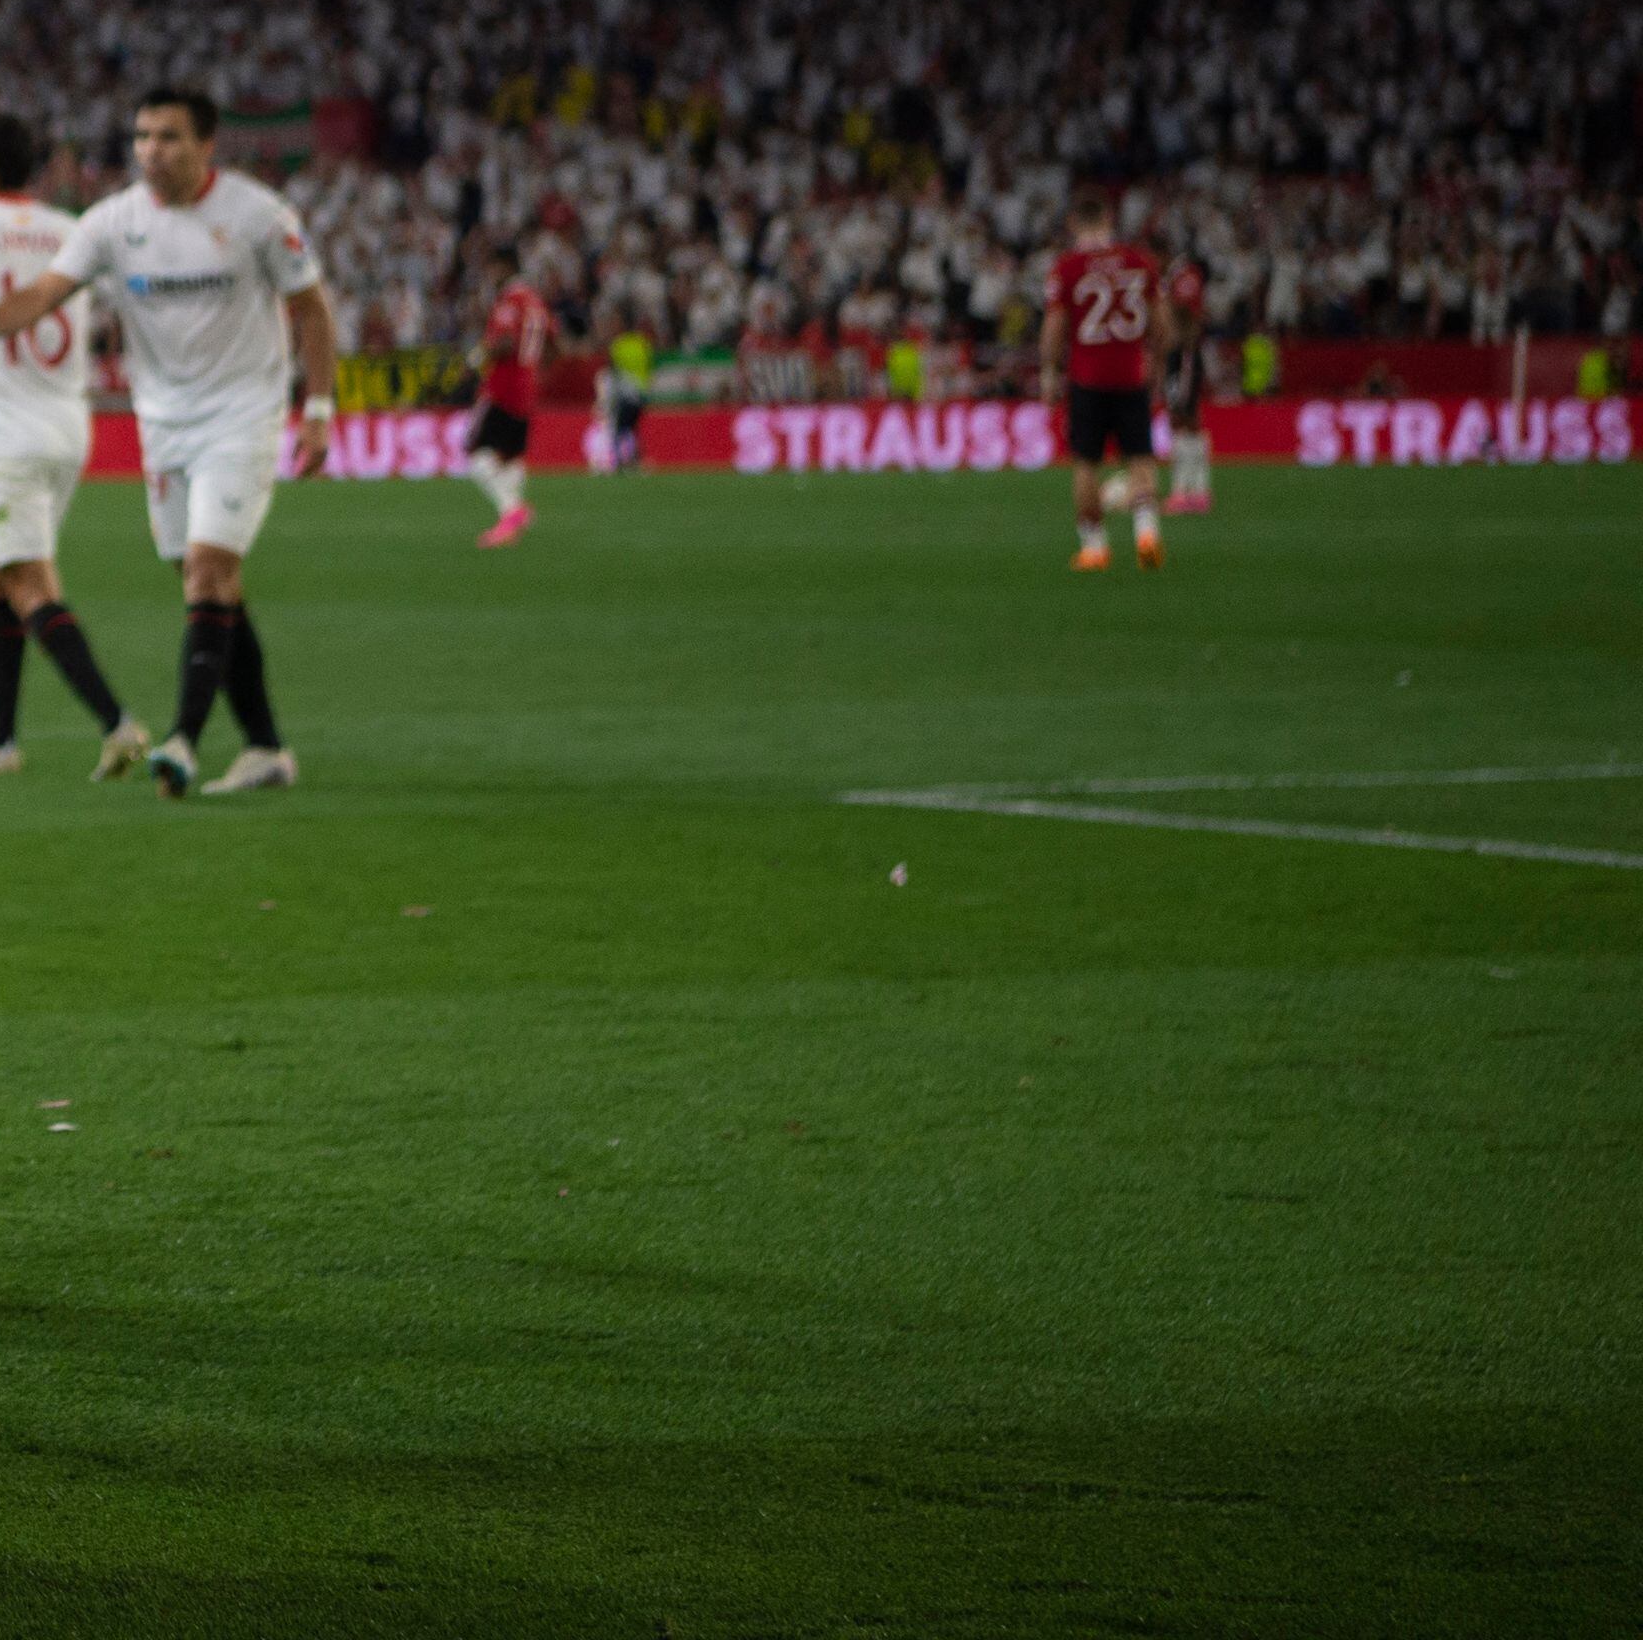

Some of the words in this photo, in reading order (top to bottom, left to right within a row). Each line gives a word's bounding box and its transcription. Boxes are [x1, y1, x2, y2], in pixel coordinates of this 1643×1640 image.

[1072, 271, 1149, 347] 23
[730, 403, 1055, 473] STRAUSS
[1294, 396, 1635, 467] STRAUSS
